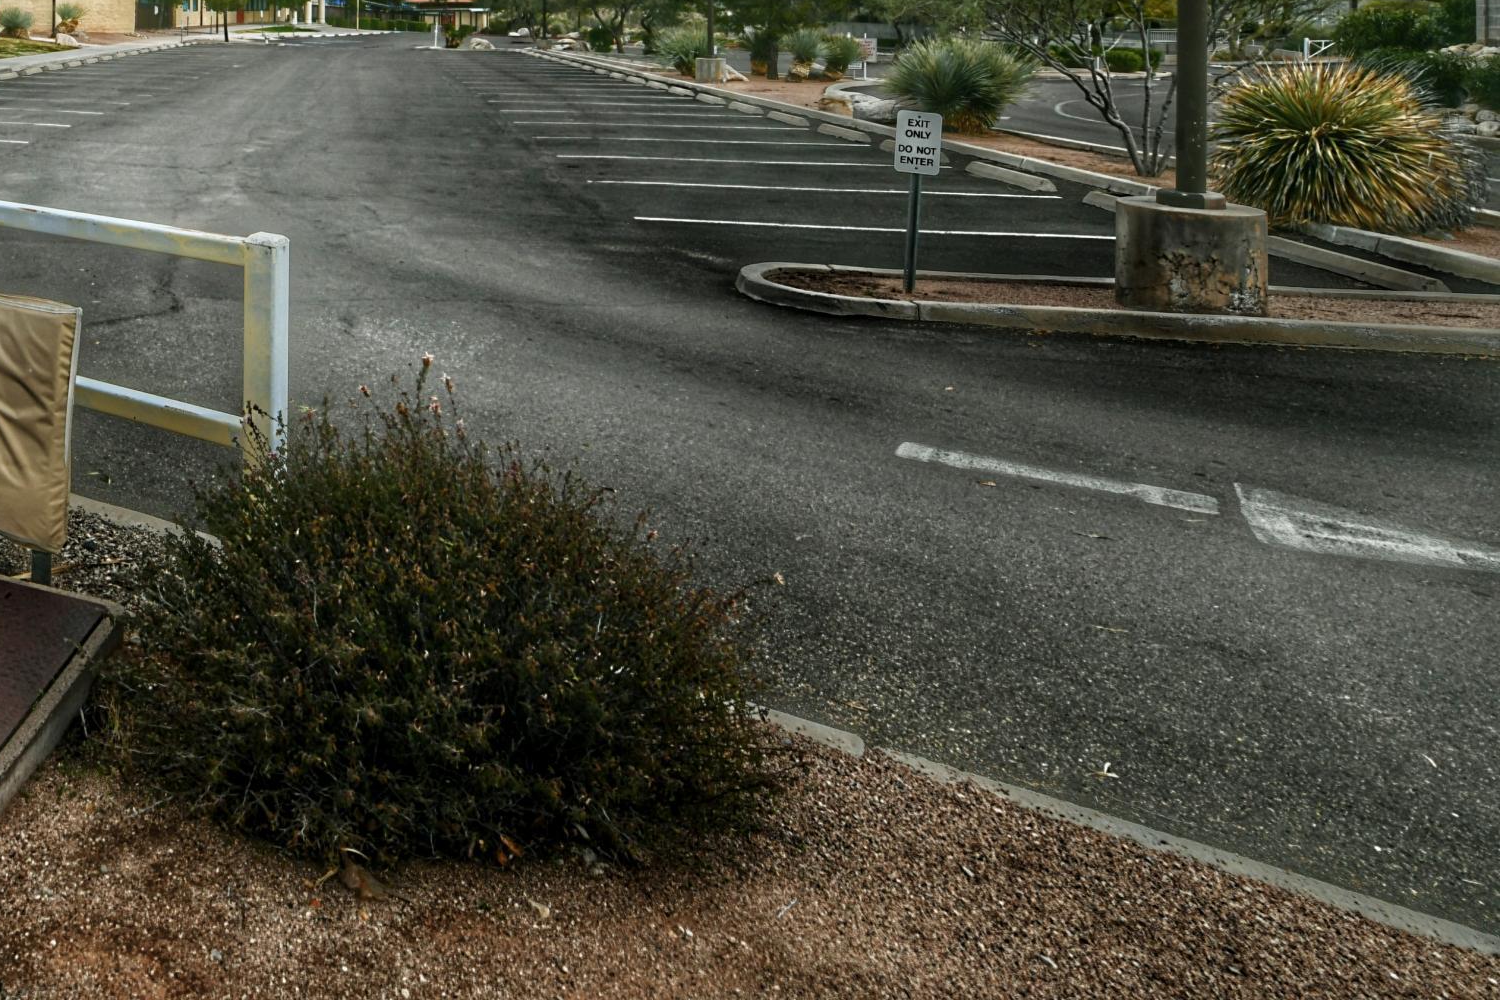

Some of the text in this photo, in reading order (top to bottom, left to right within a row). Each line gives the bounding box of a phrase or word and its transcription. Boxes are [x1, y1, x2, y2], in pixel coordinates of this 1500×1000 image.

[907, 118, 931, 128] EXIT
[905, 129, 931, 139] ONLY
[898, 144, 937, 155] DO NOT
[900, 155, 934, 167] ENTER
